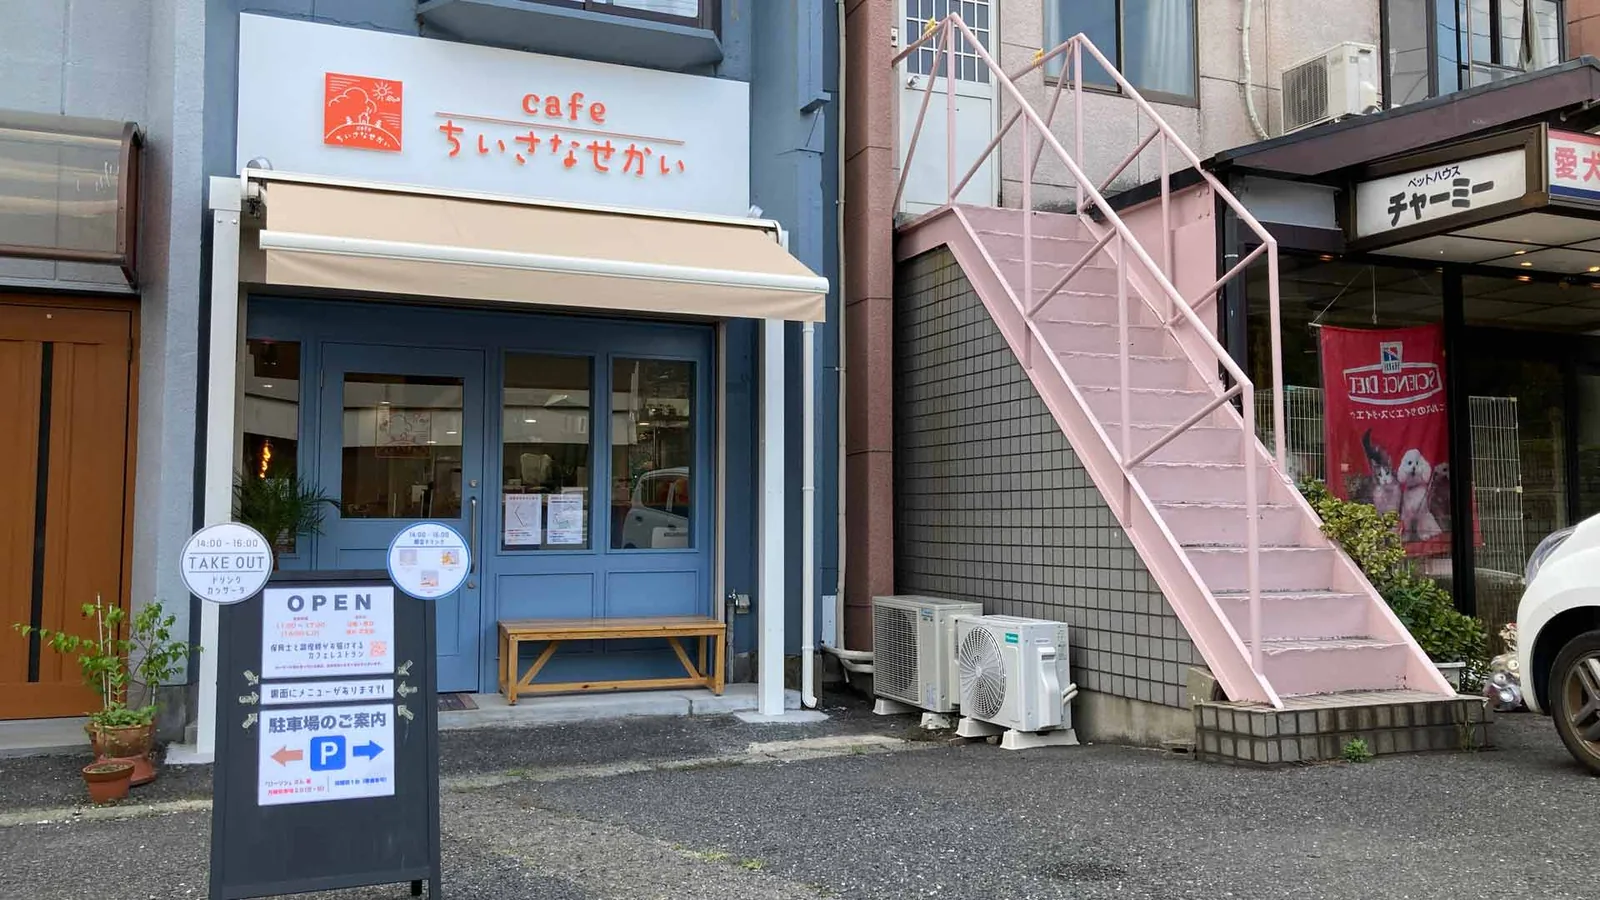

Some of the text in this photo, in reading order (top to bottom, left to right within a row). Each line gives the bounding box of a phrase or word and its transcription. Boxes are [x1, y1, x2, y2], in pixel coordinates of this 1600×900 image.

[522, 92, 606, 124] cafe
[439, 119, 685, 176] ちいさなせかい
[1408, 165, 1461, 188] ペットハウス
[1387, 177, 1494, 227] チャーミー
[197, 539, 222, 548] 14:00
[233, 538, 258, 548] 16:00
[188, 556, 265, 569] TAKE OUT
[212, 575, 241, 584] ドリンク
[287, 593, 371, 612] OPEN
[308, 651, 364, 660] カフェレストラン
[269, 711, 387, 734] 駐車場のご案内
[320, 741, 338, 765] P
